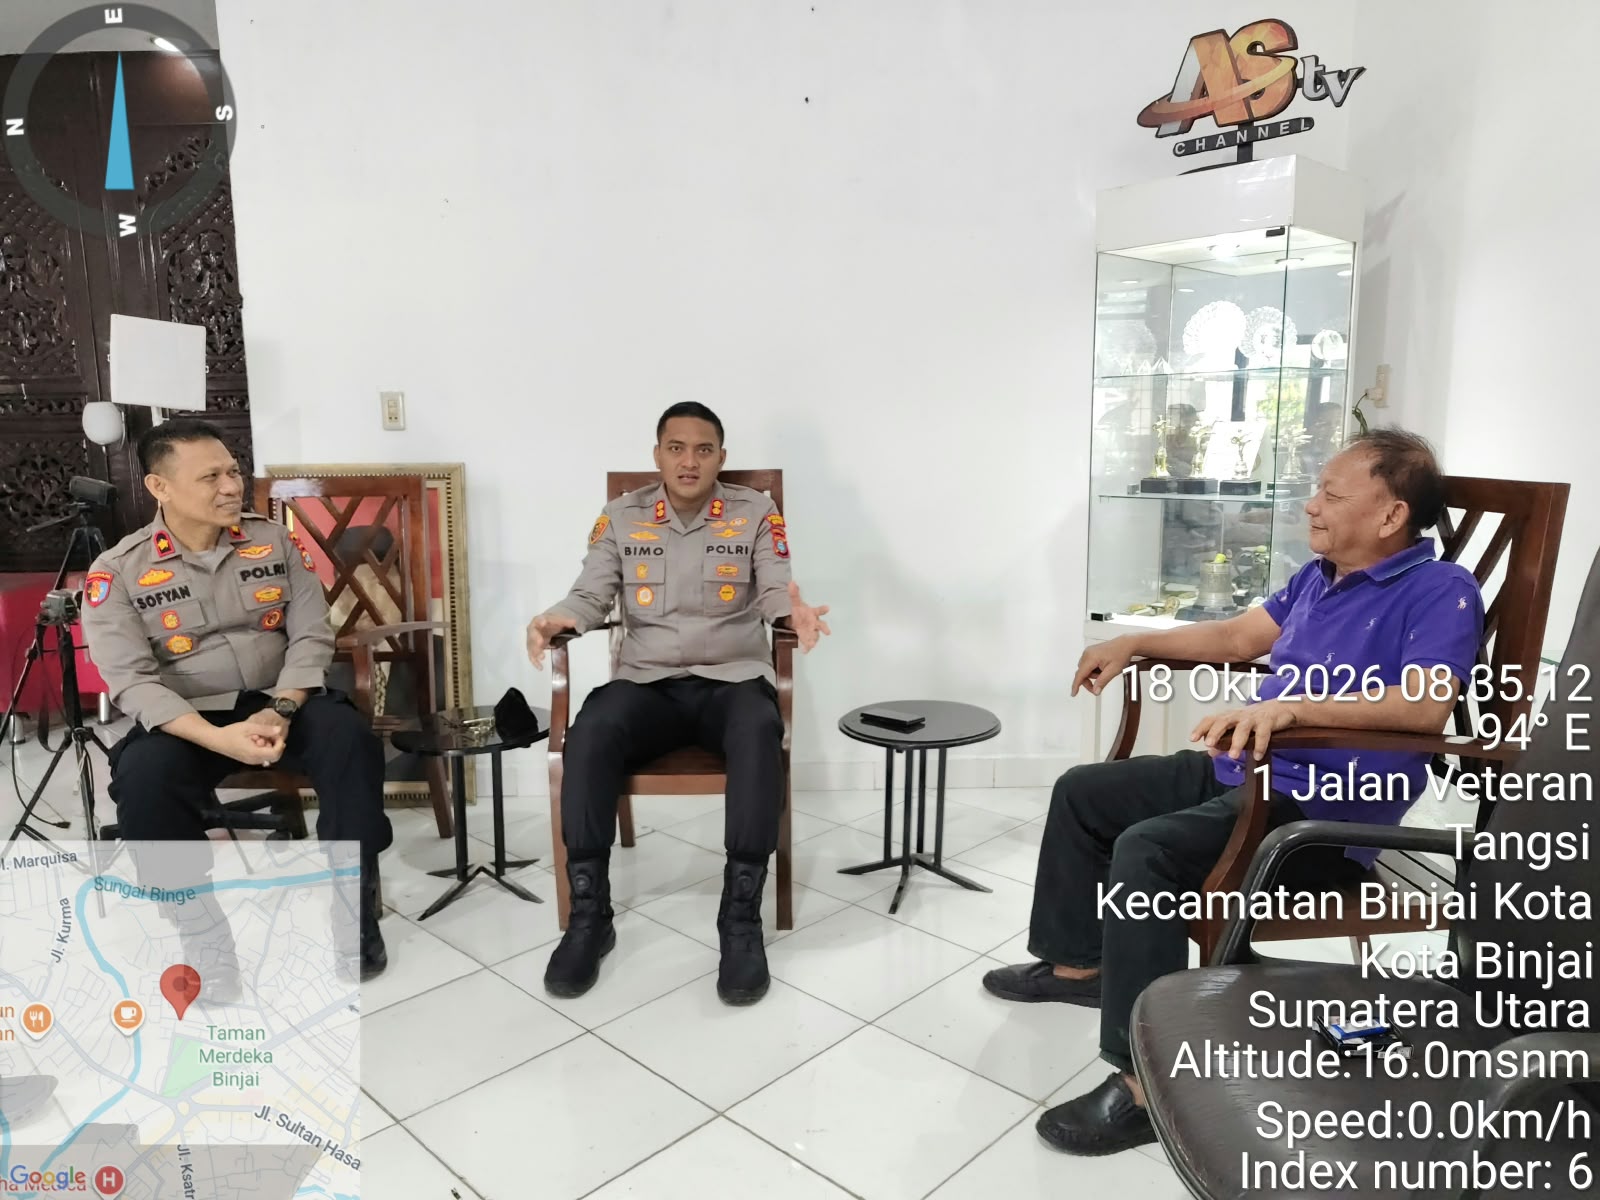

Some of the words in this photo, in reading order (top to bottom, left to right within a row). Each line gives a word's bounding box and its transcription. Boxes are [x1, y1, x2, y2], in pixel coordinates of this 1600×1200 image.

[1174, 118, 1311, 155] CHANNEL
[624, 546, 664, 556] BIMO
[706, 545, 748, 555] POLRI
[240, 563, 285, 581] POLRI
[136, 585, 191, 610] SOFYAN
